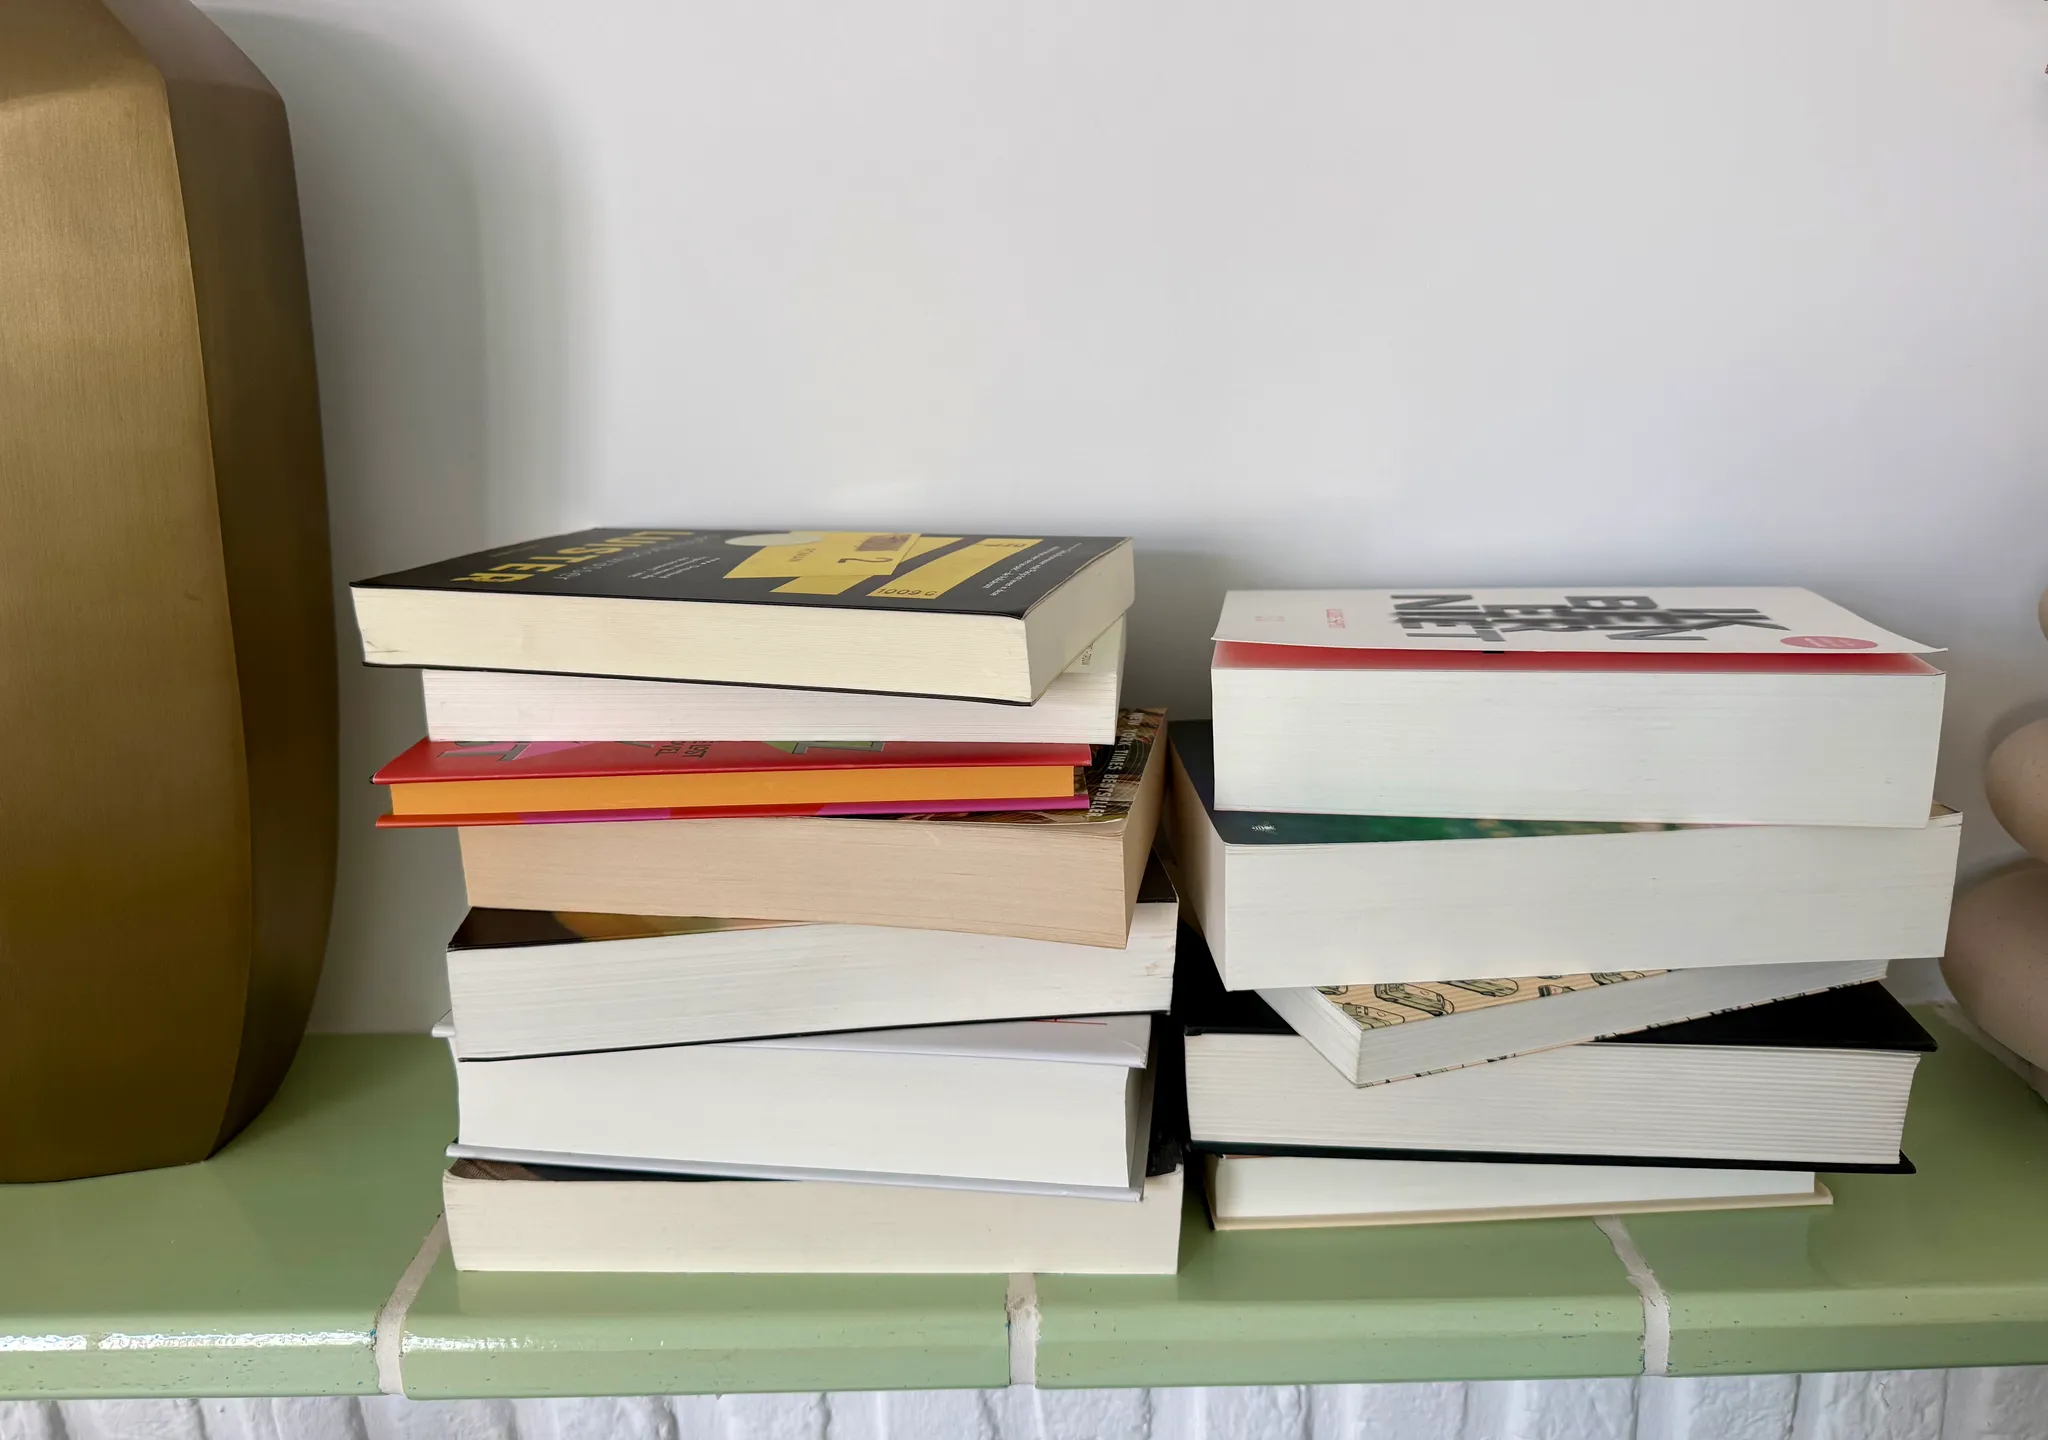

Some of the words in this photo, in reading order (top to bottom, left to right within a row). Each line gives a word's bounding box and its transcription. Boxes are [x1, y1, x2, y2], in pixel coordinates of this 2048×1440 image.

[450, 530, 694, 583] LUISTER
[1390, 594, 1506, 642] NIET
[1481, 604, 1596, 632] ER
[1563, 595, 1709, 641] BEN
[1664, 607, 1791, 632] IK
[1127, 712, 1144, 725] NEW
[1118, 728, 1139, 746] YORK
[682, 744, 712, 759] LOST
[1107, 749, 1129, 770] TIMES
[1086, 773, 1120, 817] BESTSELLER
